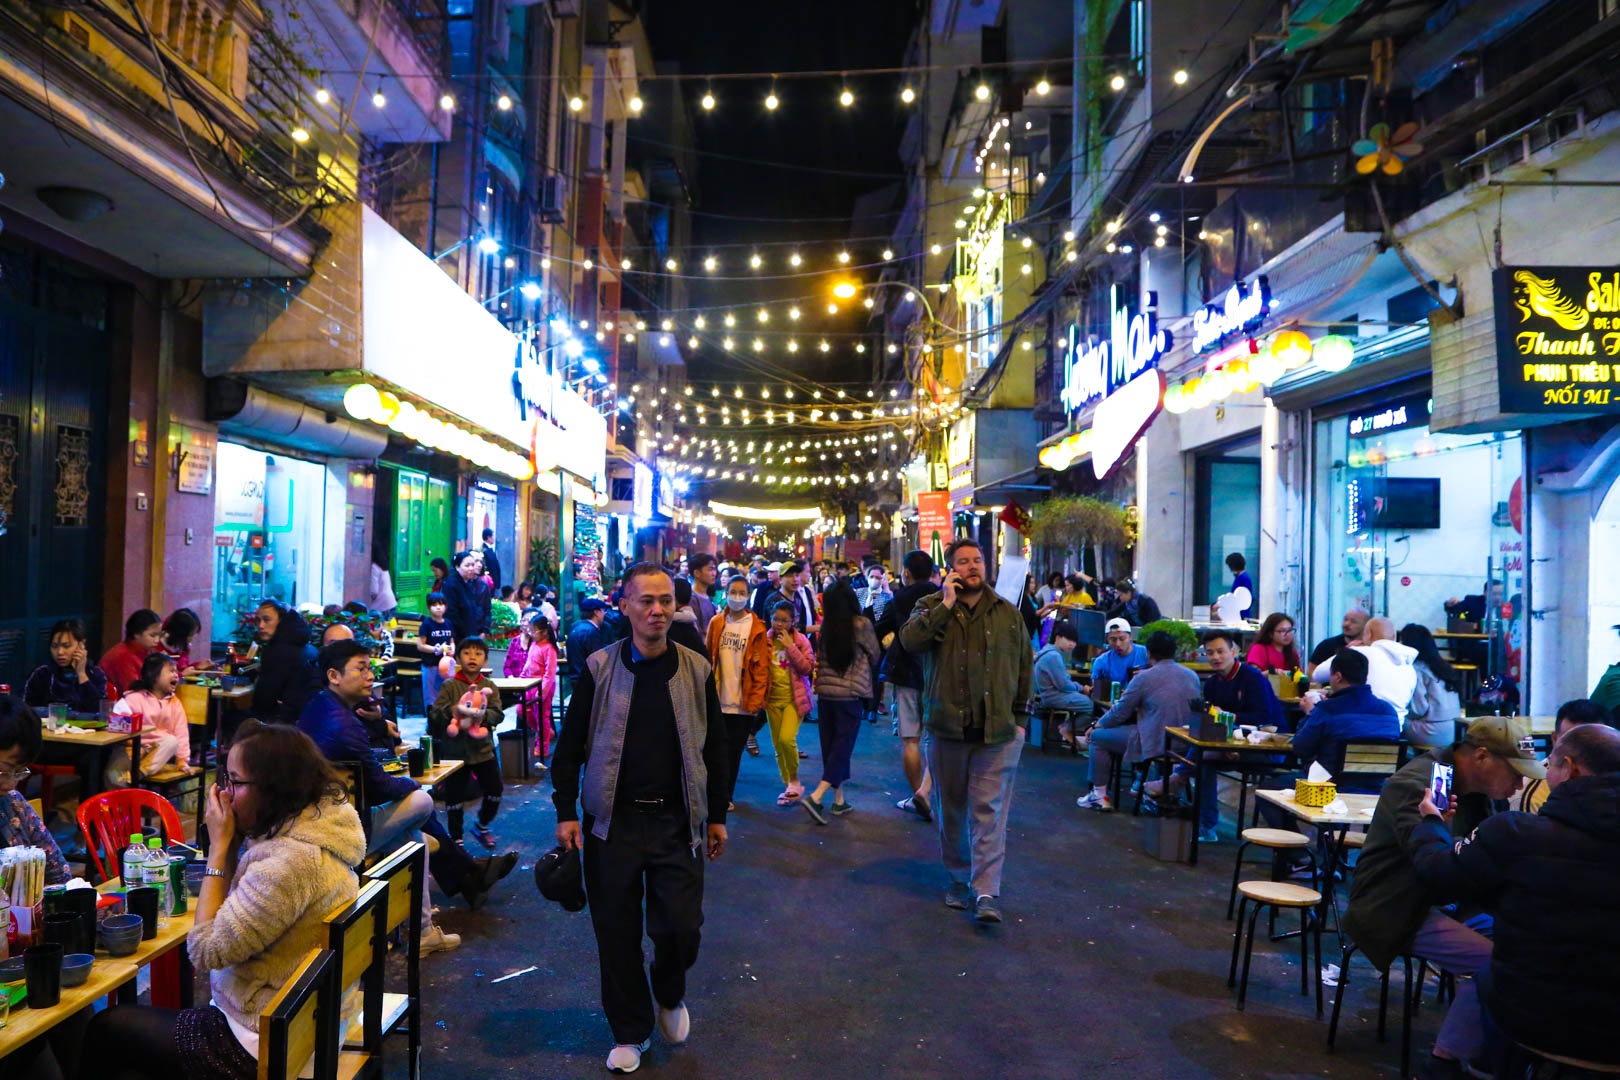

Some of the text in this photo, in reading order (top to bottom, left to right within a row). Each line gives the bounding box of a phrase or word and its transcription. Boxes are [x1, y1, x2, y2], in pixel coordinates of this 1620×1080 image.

[1586, 271, 1620, 313] Sal
[1516, 331, 1597, 355] Thanh
[1523, 363, 1567, 382] PHUN
[1570, 360, 1610, 382] THÊU
[1544, 383, 1611, 405] NỐI MI
[1363, 416, 1374, 432] 27
